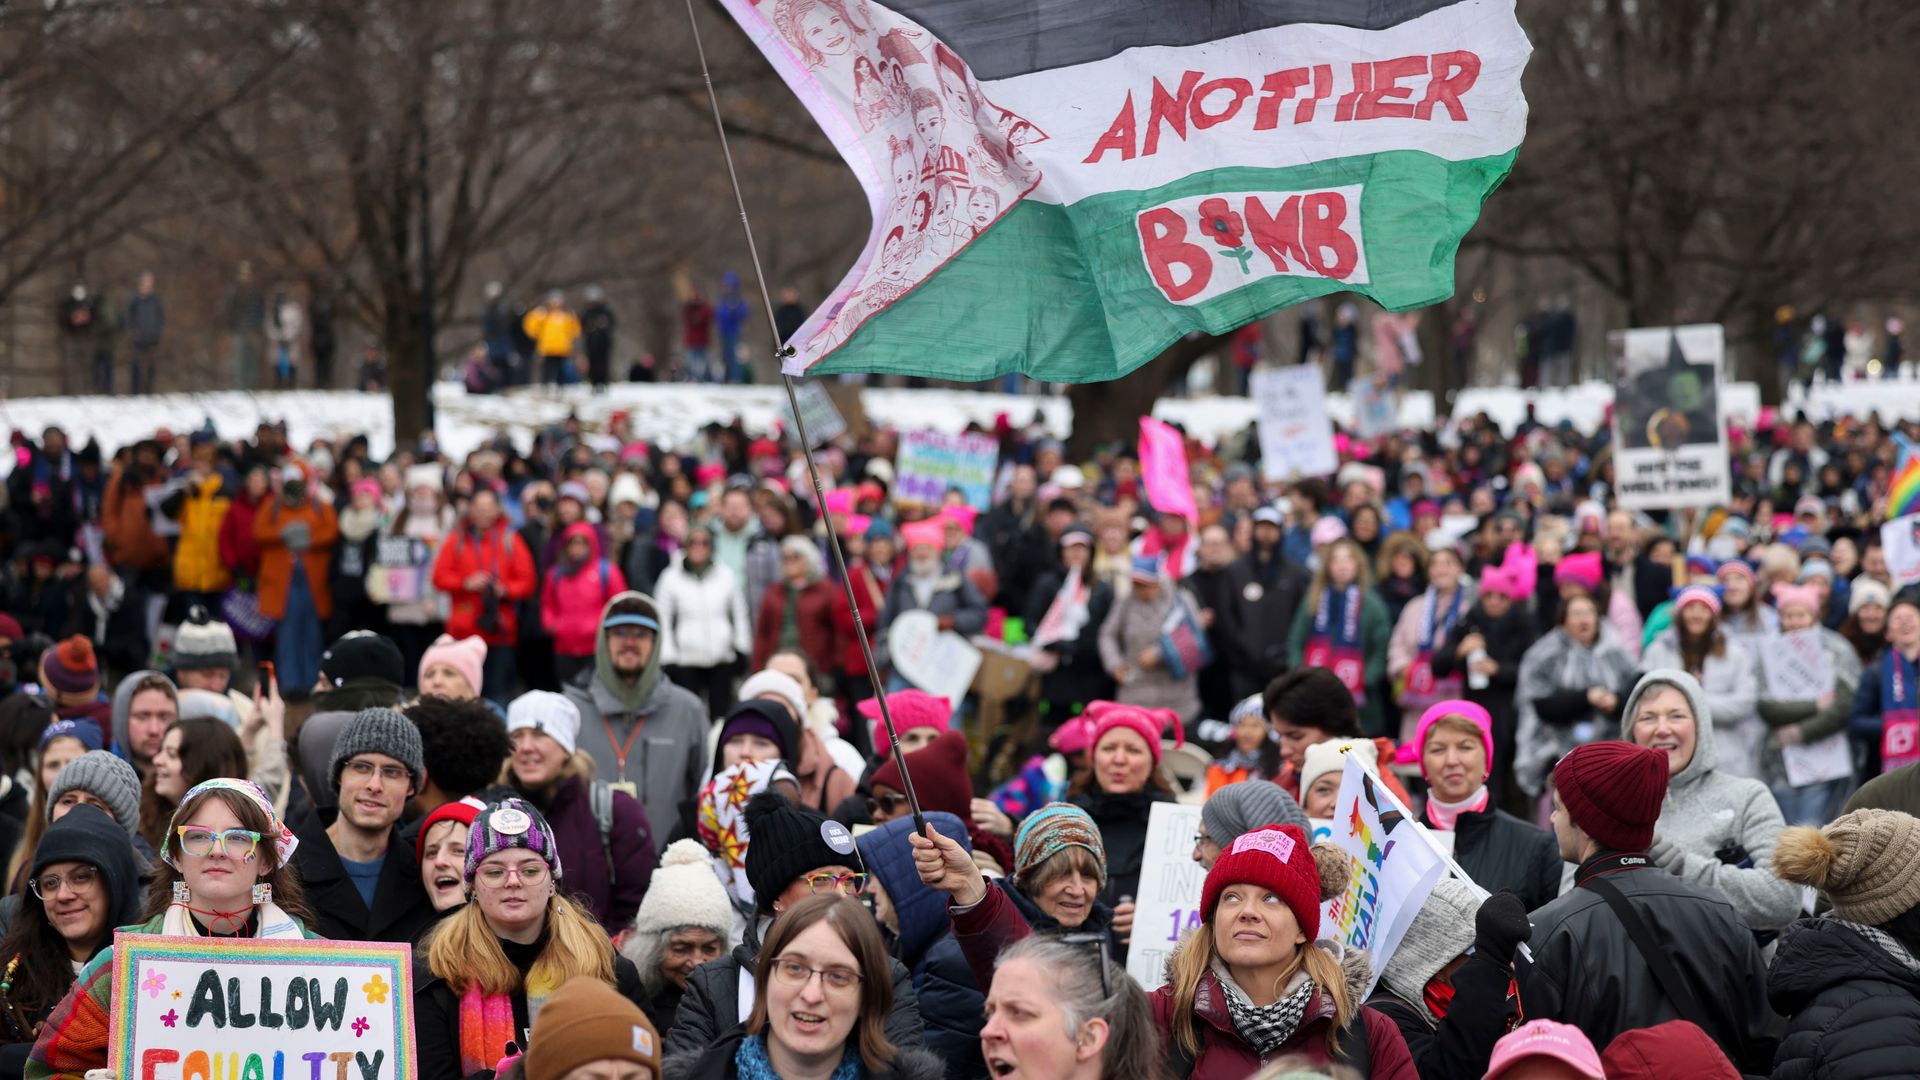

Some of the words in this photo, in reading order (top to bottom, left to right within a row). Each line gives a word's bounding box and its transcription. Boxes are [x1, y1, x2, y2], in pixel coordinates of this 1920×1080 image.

[831, 835, 850, 845] TRUMP
[1620, 857, 1647, 866] Canon
[185, 968, 349, 1032] ALLOW
